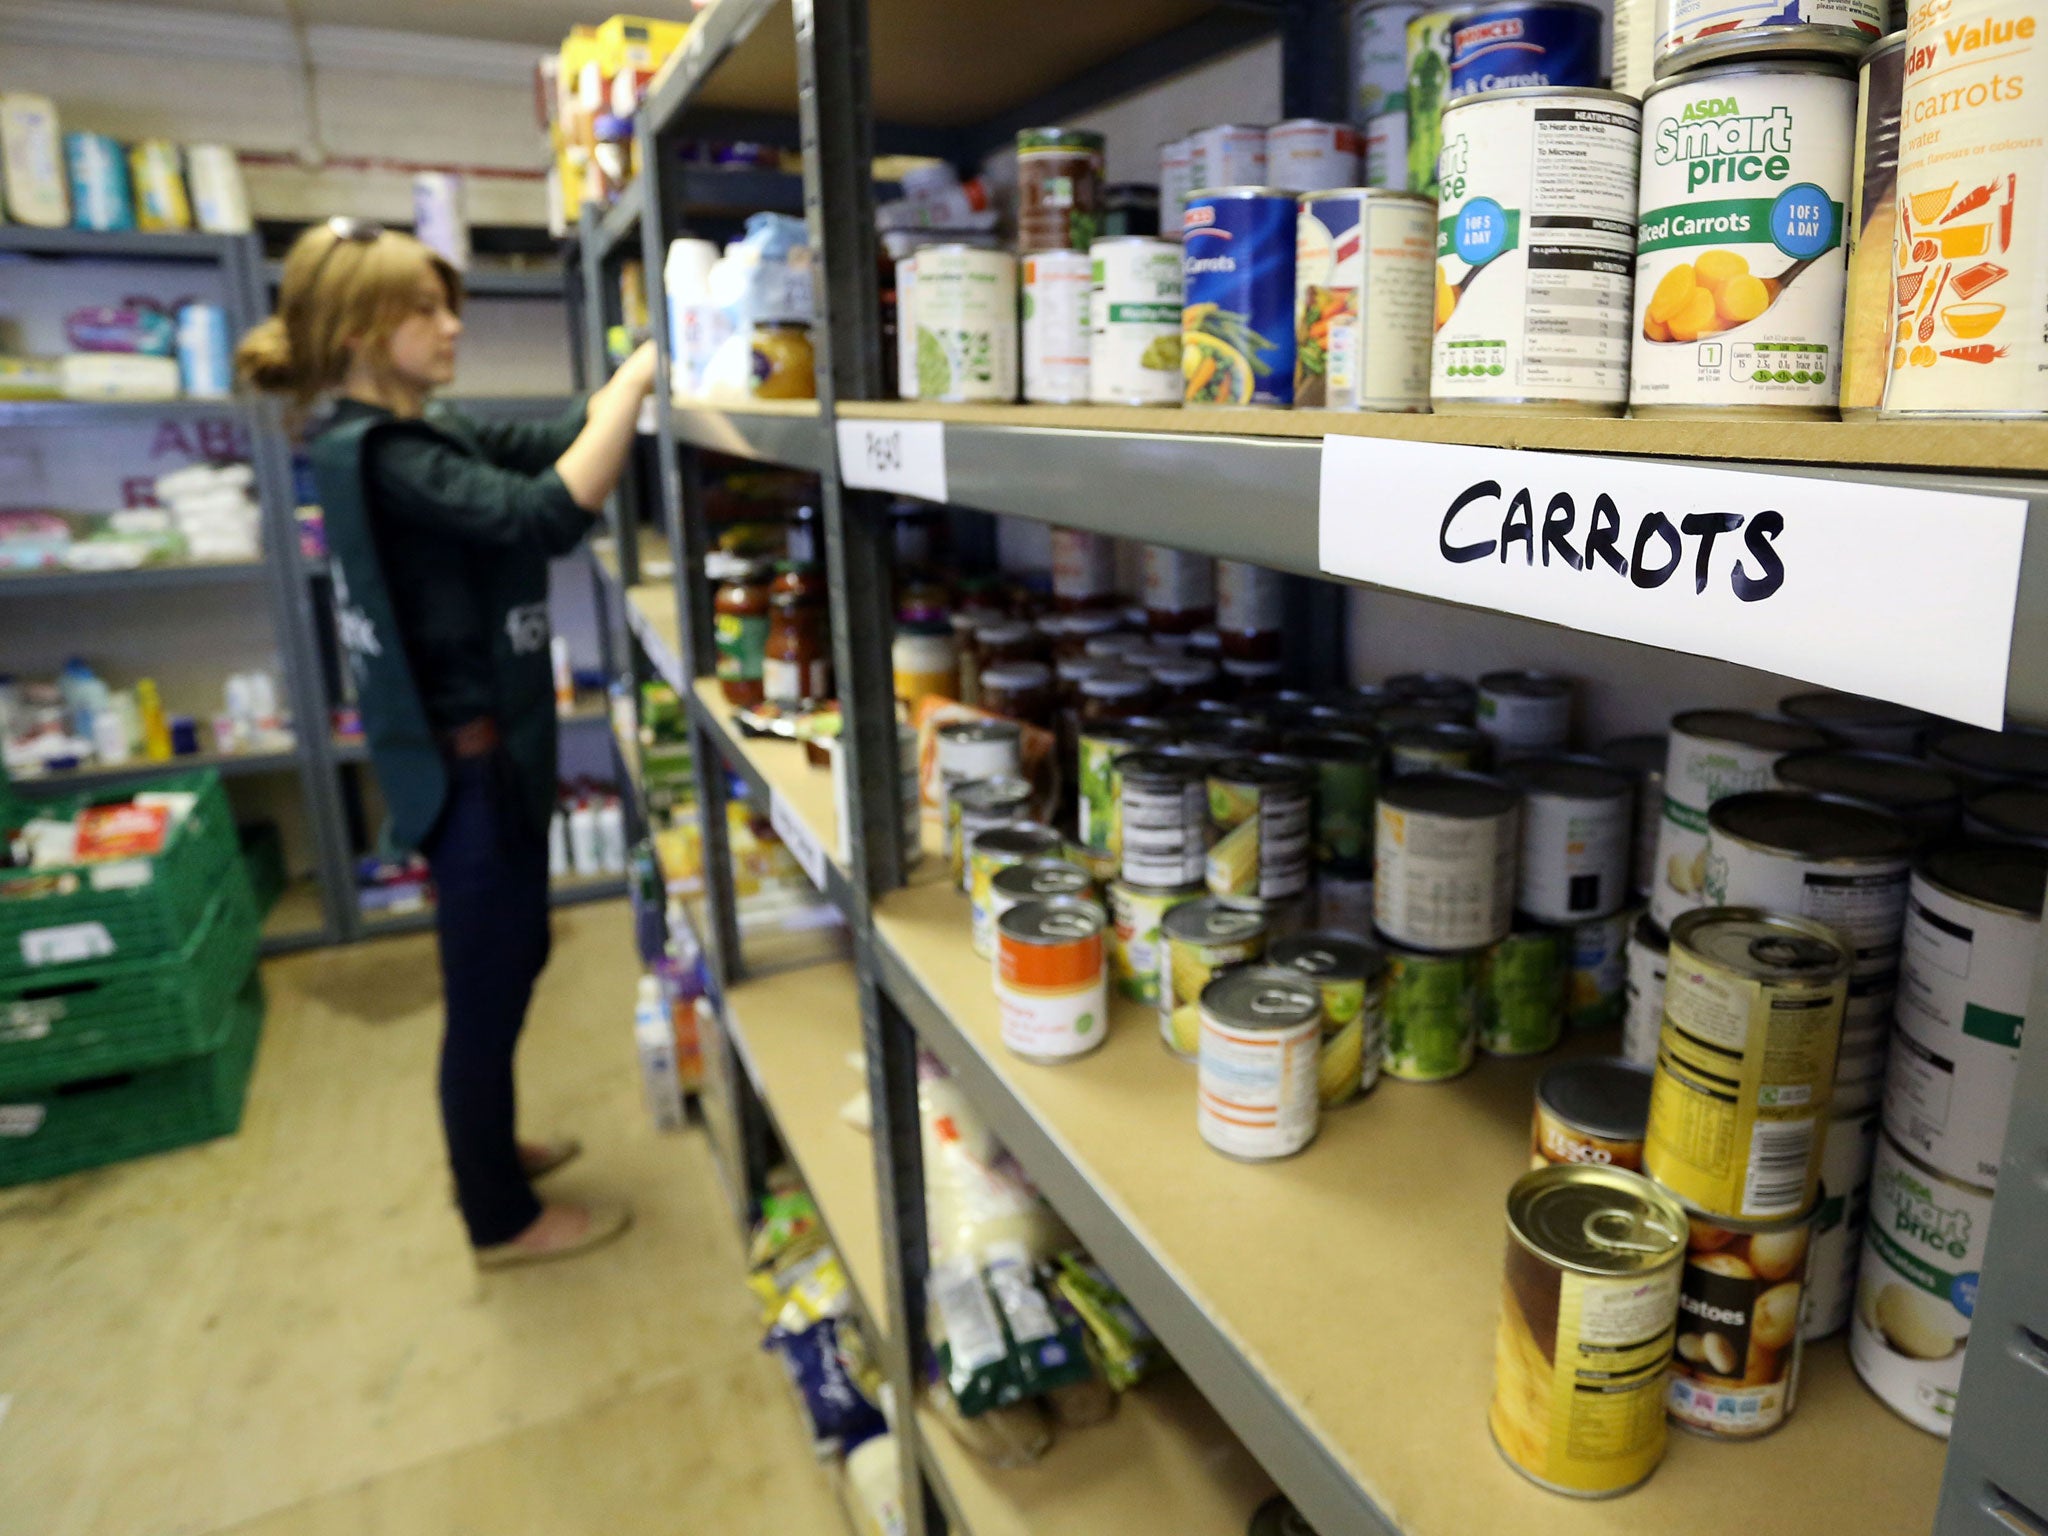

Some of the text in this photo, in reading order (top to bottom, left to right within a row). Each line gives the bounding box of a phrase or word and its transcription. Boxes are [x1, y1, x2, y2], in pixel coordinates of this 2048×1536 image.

[1944, 16, 2036, 56] Value
[1914, 74, 2024, 124] carrots
[1575, 110, 1611, 122] HEATING
[1681, 96, 1740, 122] ASDA
[1538, 123, 1548, 131] To
[1655, 106, 1793, 166] Smart
[1909, 129, 1941, 151] water
[1538, 148, 1547, 156] To
[1928, 147, 1970, 166] flavours
[1973, 145, 1986, 158] or
[1989, 137, 2045, 152] colours
[1688, 155, 1790, 194] price
[1471, 216, 1482, 229] OF
[1484, 215, 1491, 229] 5
[1789, 205, 1820, 220] 1 OF 5
[1672, 212, 1750, 236] Carrots
[1787, 222, 1820, 237] A DAY
[1463, 232, 1471, 246] A
[1471, 231, 1491, 245] DAY
[1706, 347, 1714, 363] 1
[1738, 360, 1746, 369] 15
[1757, 352, 1770, 360] Sugar
[1796, 360, 1811, 370] Trace
[1439, 479, 1785, 603] CARROTS
[1895, 1211, 1967, 1259] price
[1680, 1293, 1746, 1327] tatoes
